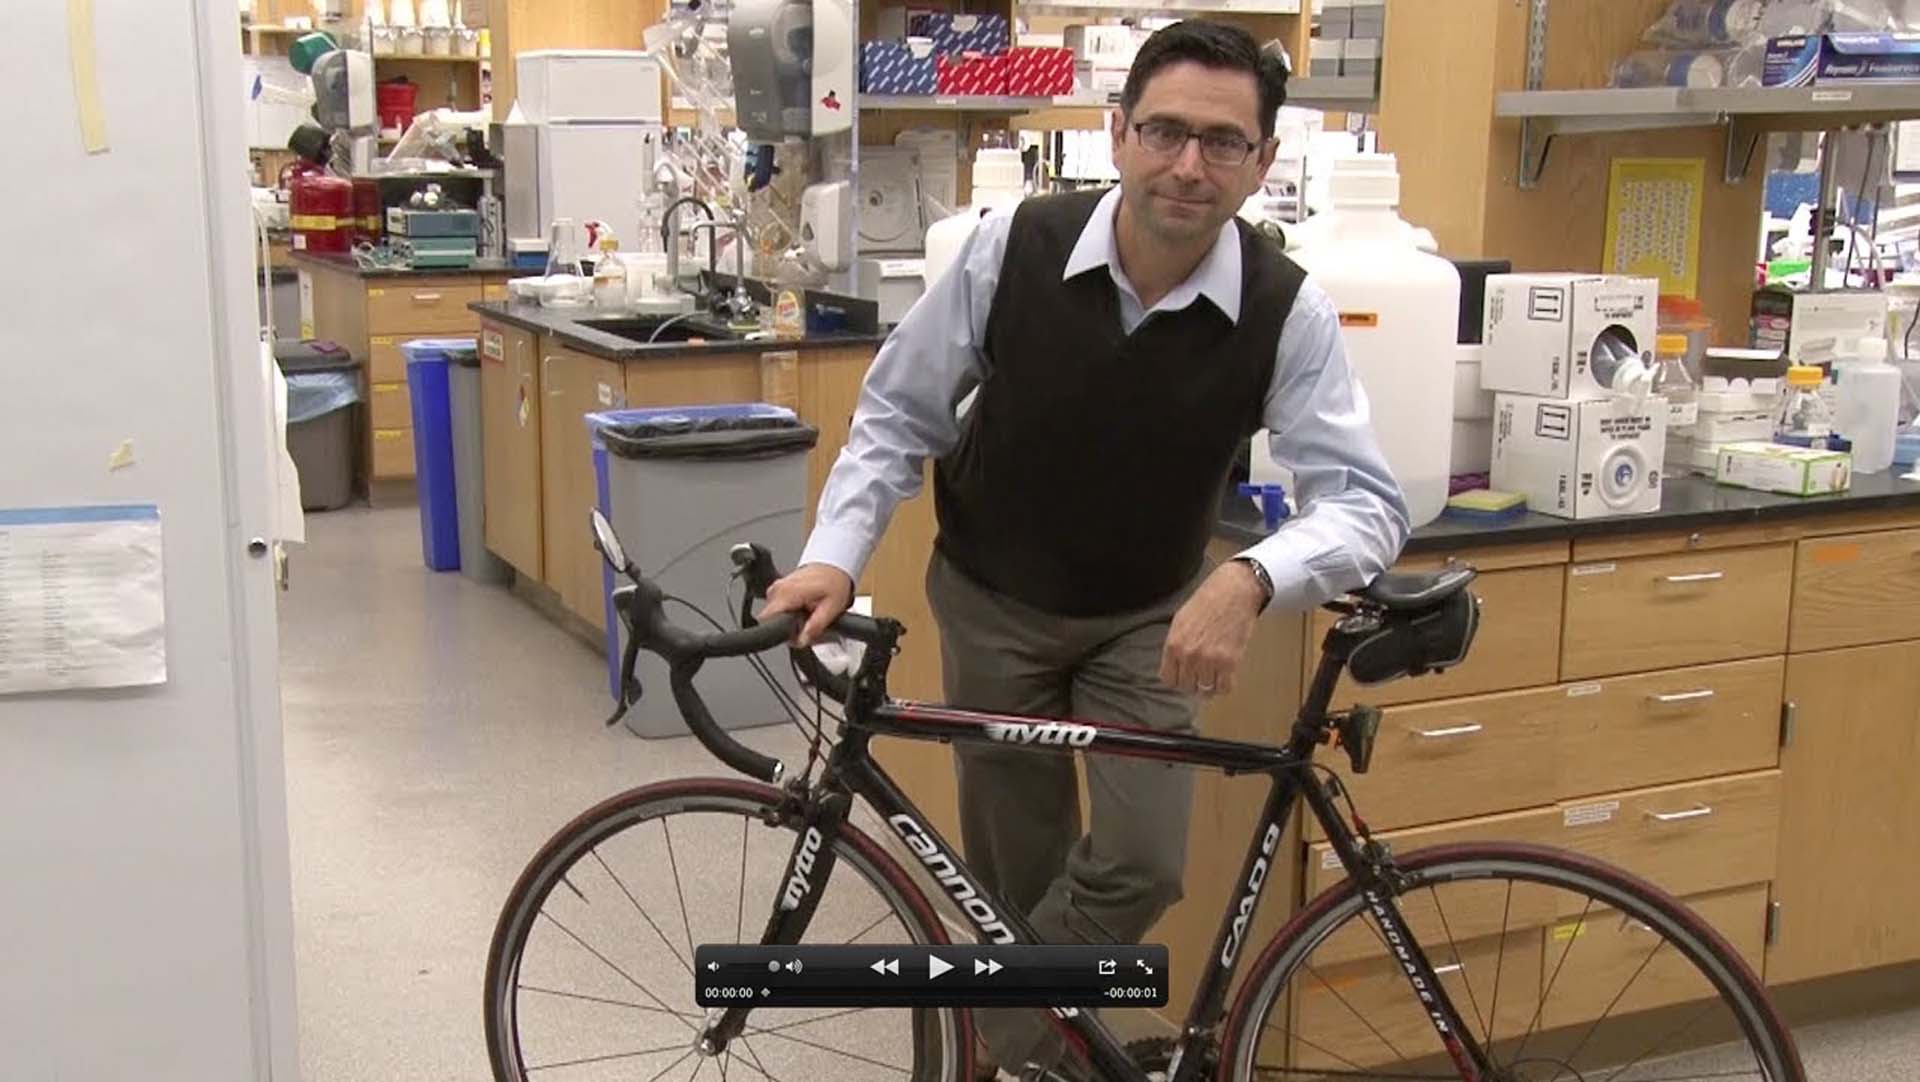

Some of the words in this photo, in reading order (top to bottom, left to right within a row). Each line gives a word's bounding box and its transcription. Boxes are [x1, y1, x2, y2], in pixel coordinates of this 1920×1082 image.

[983, 721, 1097, 747] nytro
[780, 826, 822, 911] nytro
[1220, 856, 1267, 969] CAAD
[1365, 890, 1433, 1003] HANDMADE
[1430, 1011, 1449, 1034] IN
